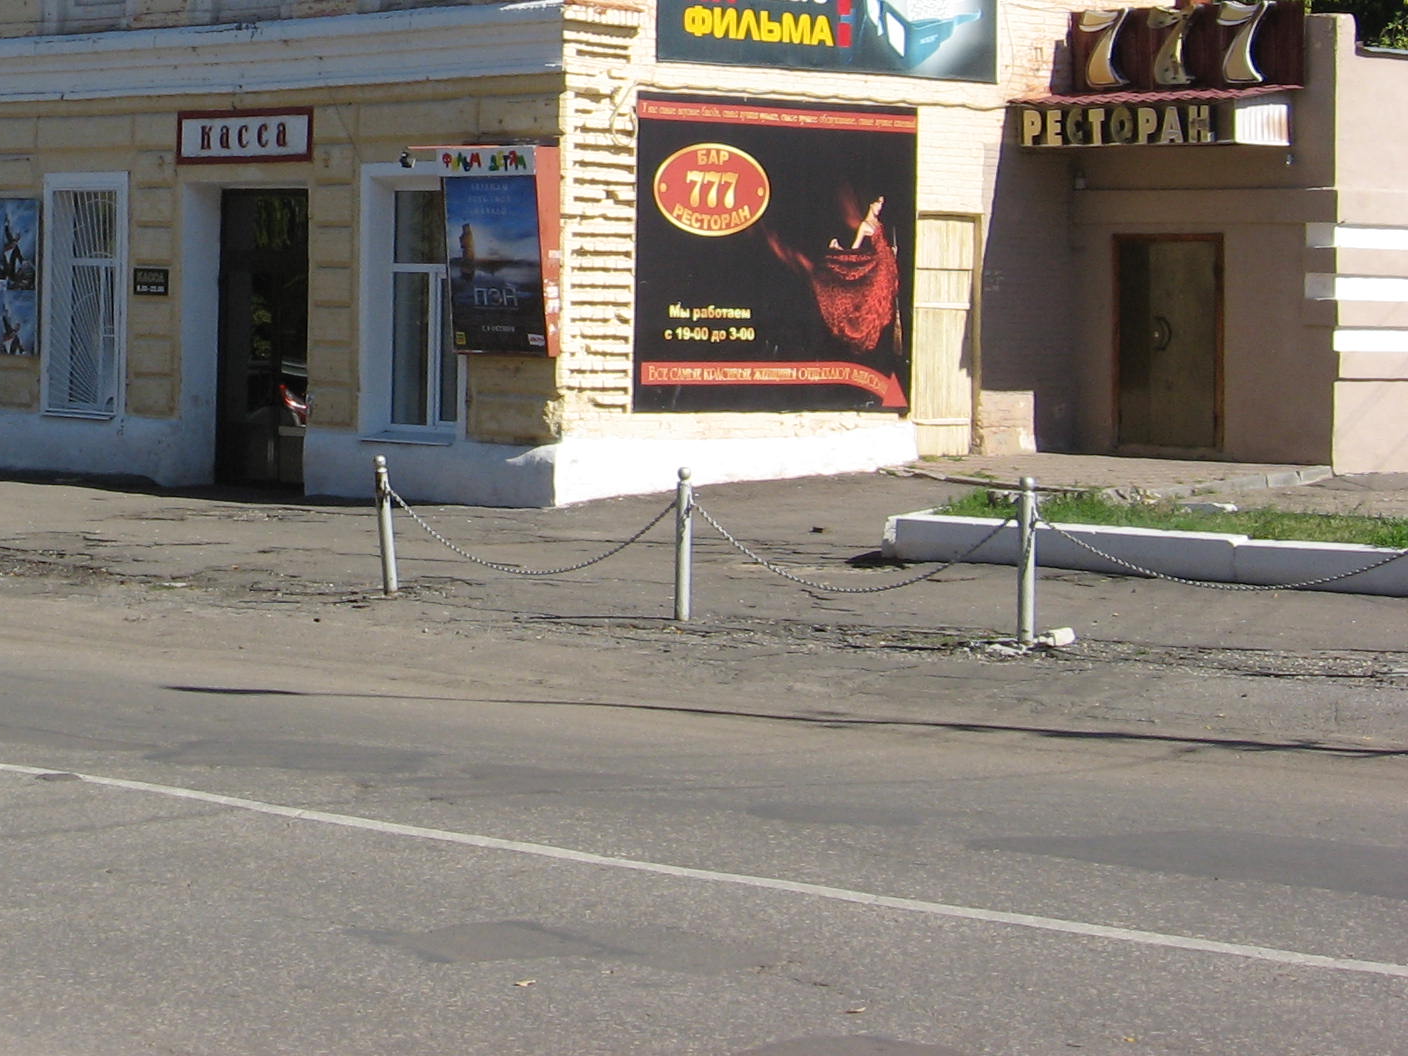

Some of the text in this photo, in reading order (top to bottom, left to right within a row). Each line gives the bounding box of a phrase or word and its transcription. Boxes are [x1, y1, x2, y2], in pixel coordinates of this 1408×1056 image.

[684, 4, 835, 47] ФИЛЬМА
[1022, 104, 1214, 146] РЕСТОРАН
[697, 148, 730, 166] БАР
[686, 170, 739, 209] 777
[672, 203, 752, 231] РЕСТОРАН
[669, 305, 752, 322] Мы работаем
[675, 326, 710, 341] 19-00
[711, 329, 728, 343] до
[728, 326, 756, 341] 3-00
